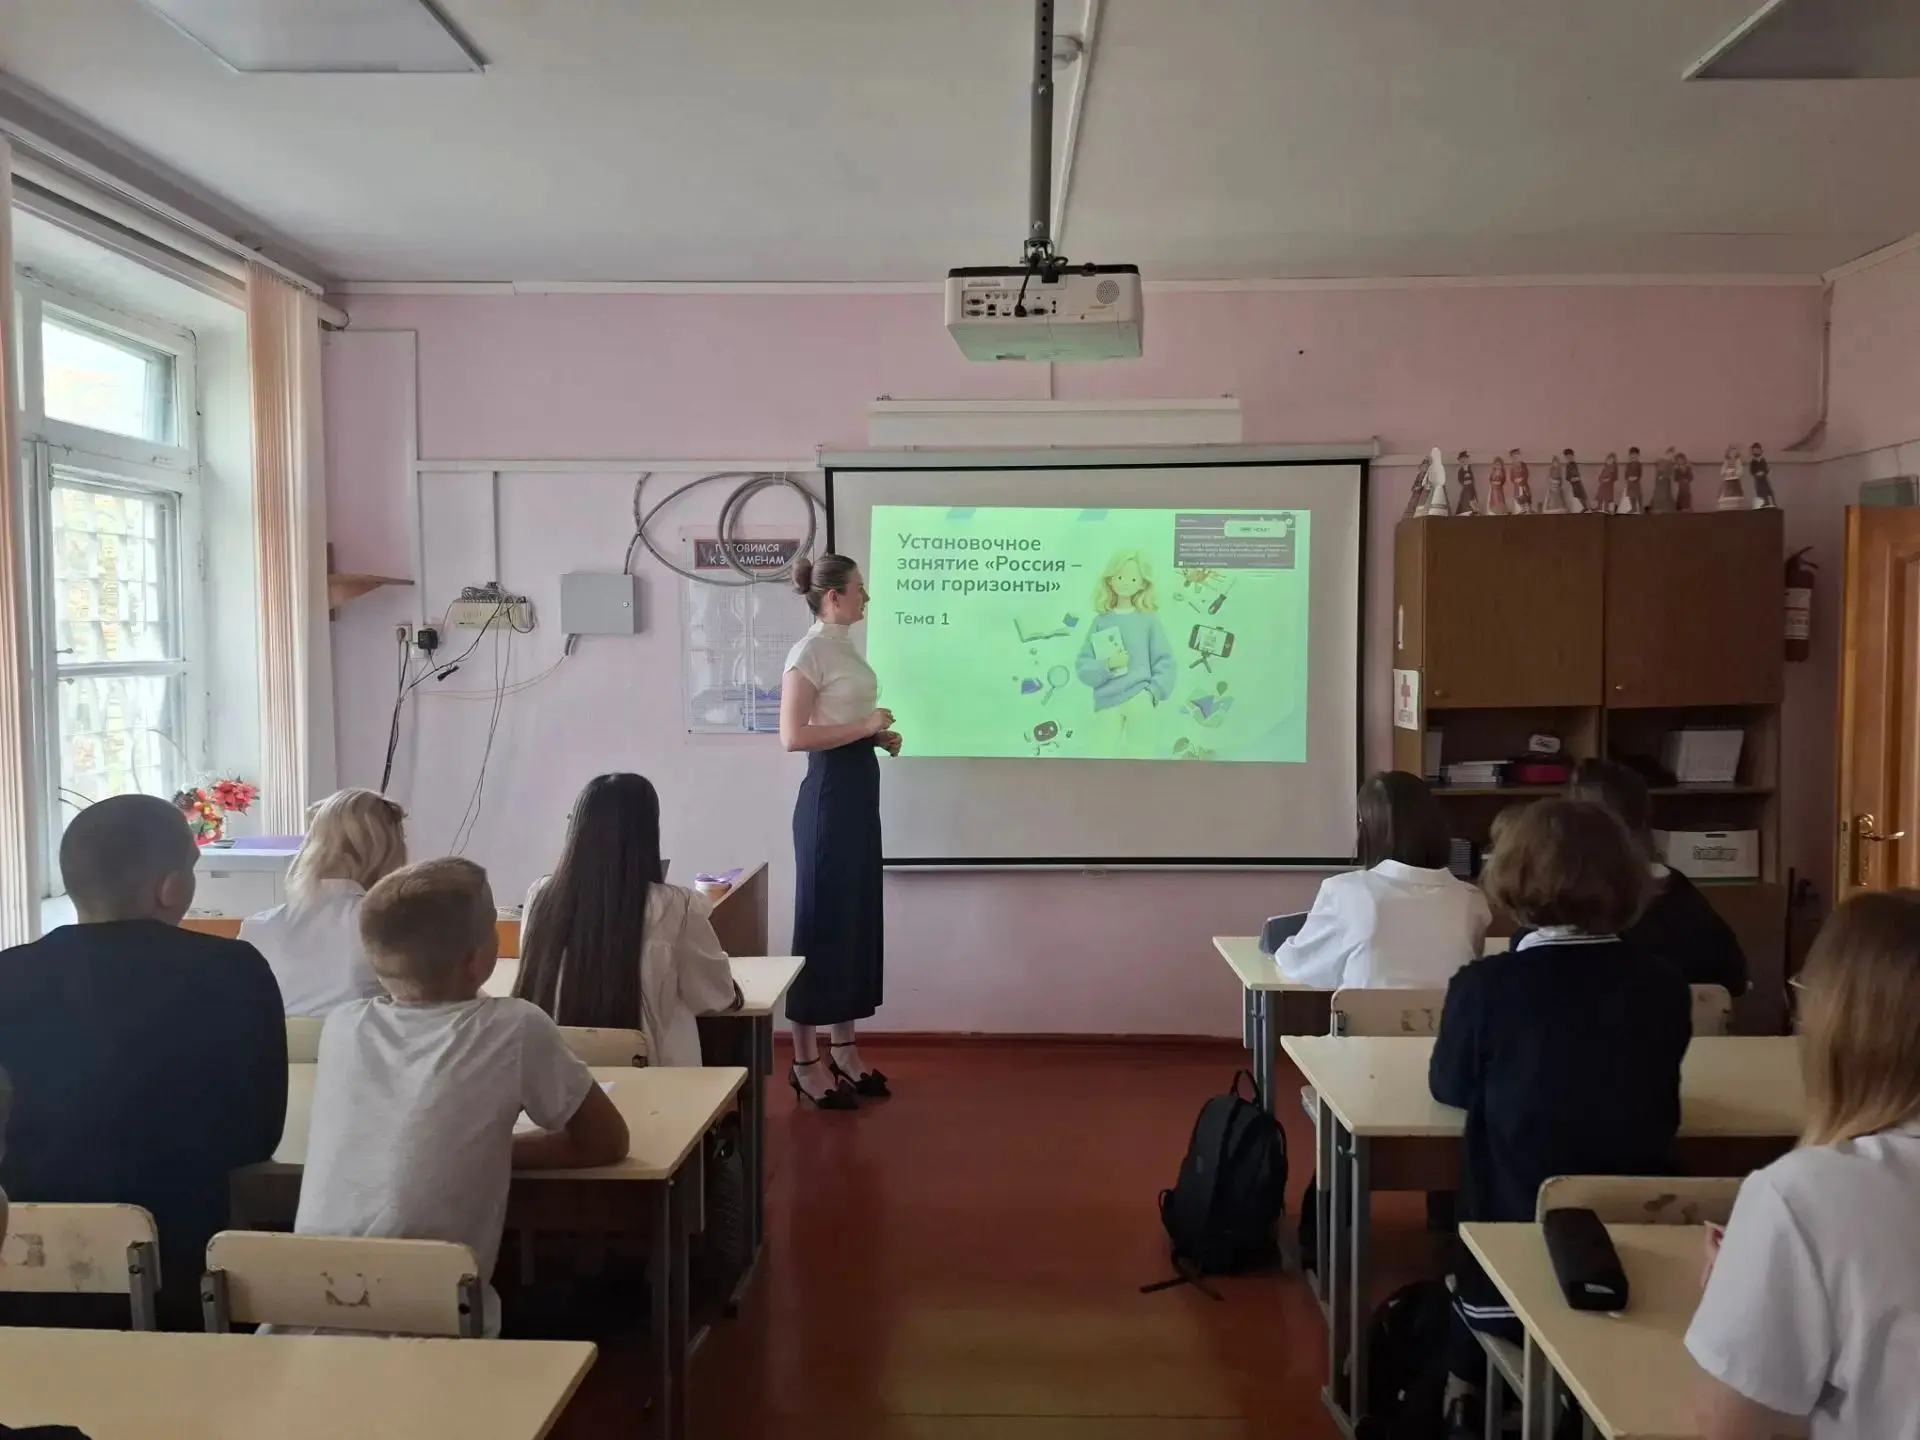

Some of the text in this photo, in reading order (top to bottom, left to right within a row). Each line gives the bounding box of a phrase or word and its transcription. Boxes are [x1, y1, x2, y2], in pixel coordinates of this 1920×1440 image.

[897, 533, 1041, 551] Установочное
[719, 555, 785, 565] ЭАМЕНАМ
[897, 557, 979, 571] занятие
[985, 555, 1065, 572] «Россия
[896, 578, 1061, 595] мои горизонты»
[895, 611, 950, 625] Тема 1
